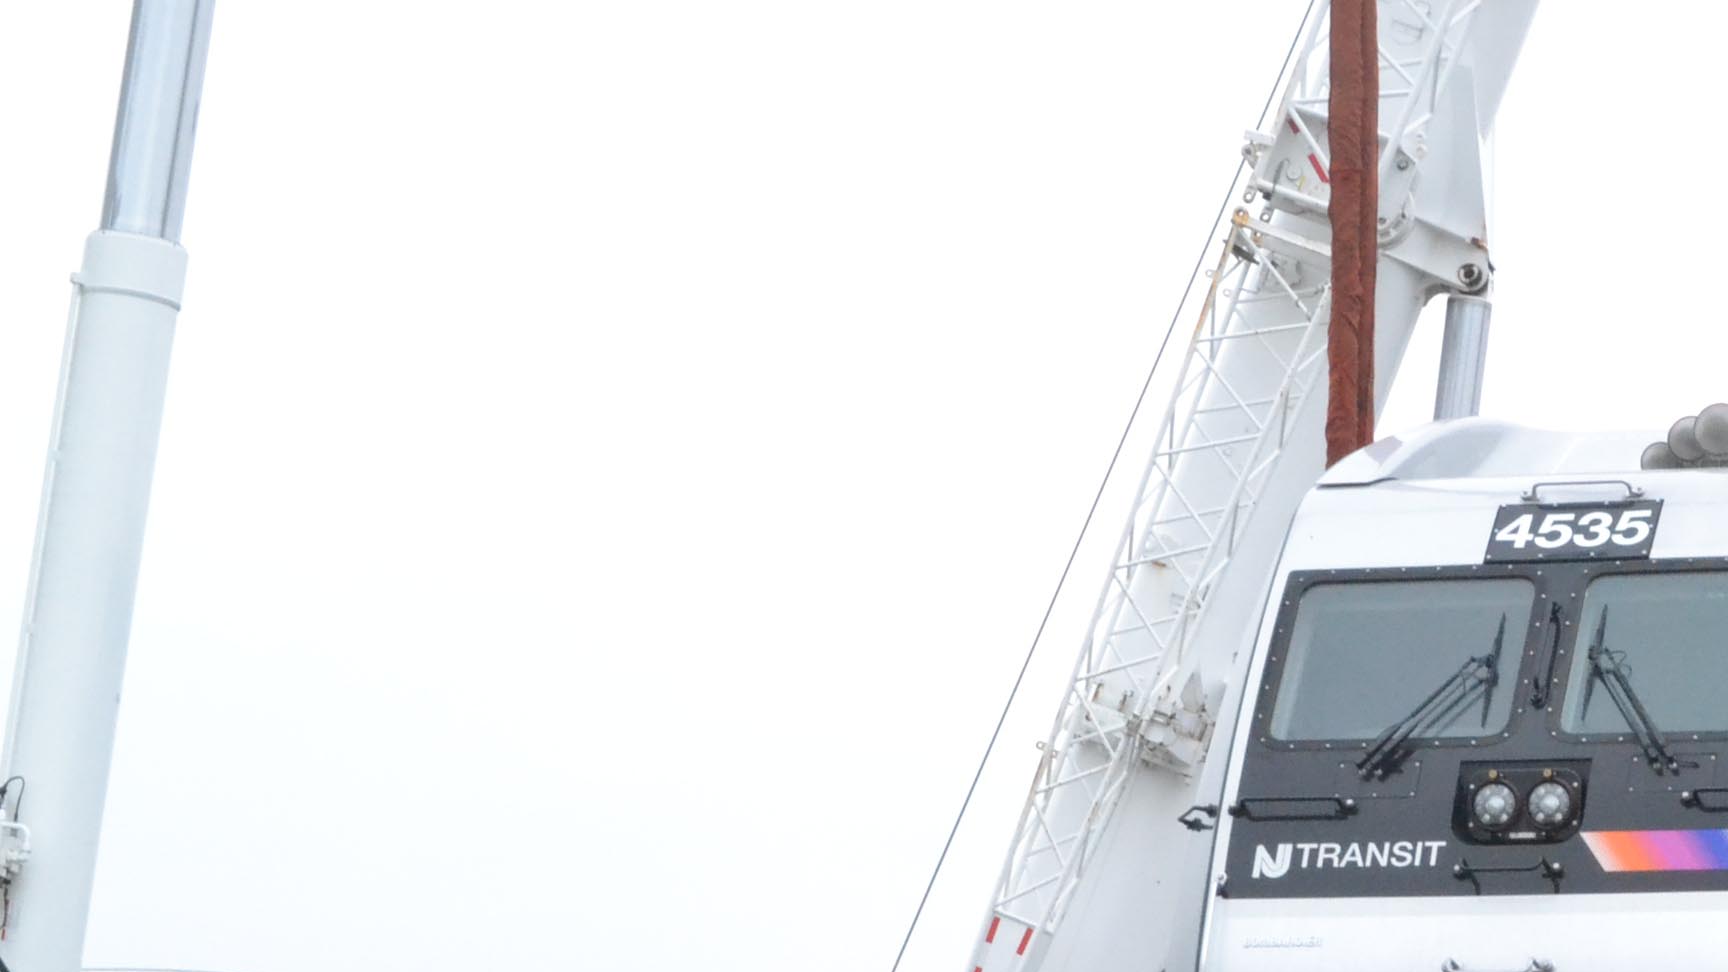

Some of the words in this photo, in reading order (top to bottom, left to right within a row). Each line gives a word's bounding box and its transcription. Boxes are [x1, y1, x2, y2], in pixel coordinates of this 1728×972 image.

[1494, 509, 1653, 549] 4535
[1251, 843, 1293, 879] NJ
[1296, 840, 1447, 869] TRANSIT
